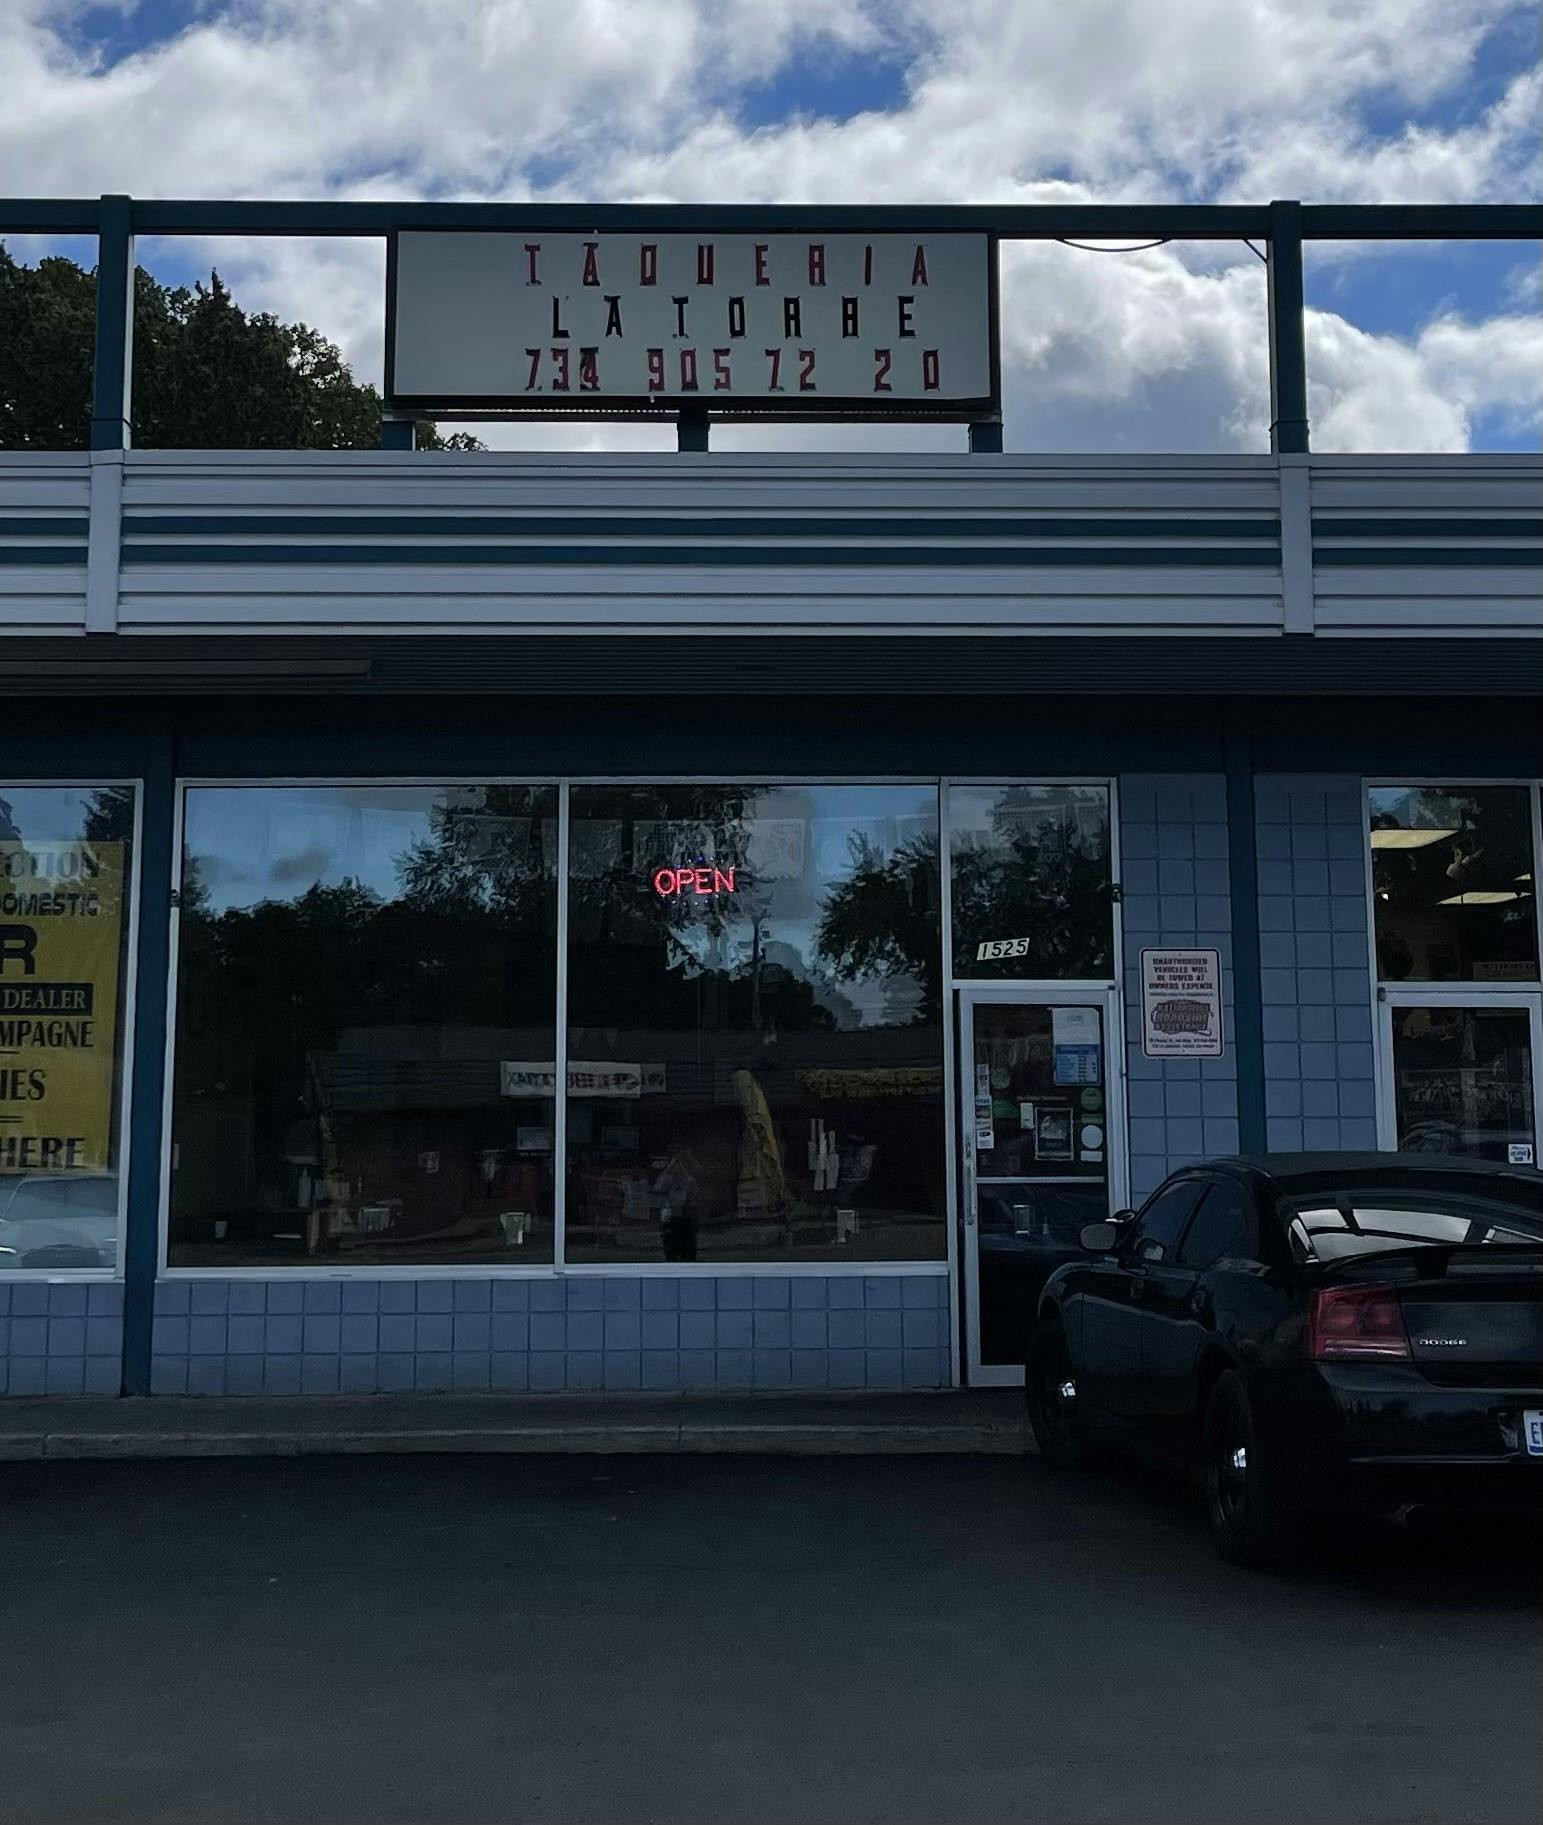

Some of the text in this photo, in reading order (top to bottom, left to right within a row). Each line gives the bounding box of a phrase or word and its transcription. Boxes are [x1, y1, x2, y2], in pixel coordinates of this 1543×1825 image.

[552, 295, 624, 338] LA
[525, 347, 600, 392] 734
[646, 347, 732, 392] 905
[654, 866, 735, 897] OPEN
[0, 892, 98, 916] OMESTIC
[982, 939, 1027, 958] 1525
[2, 989, 87, 1009] DEALER
